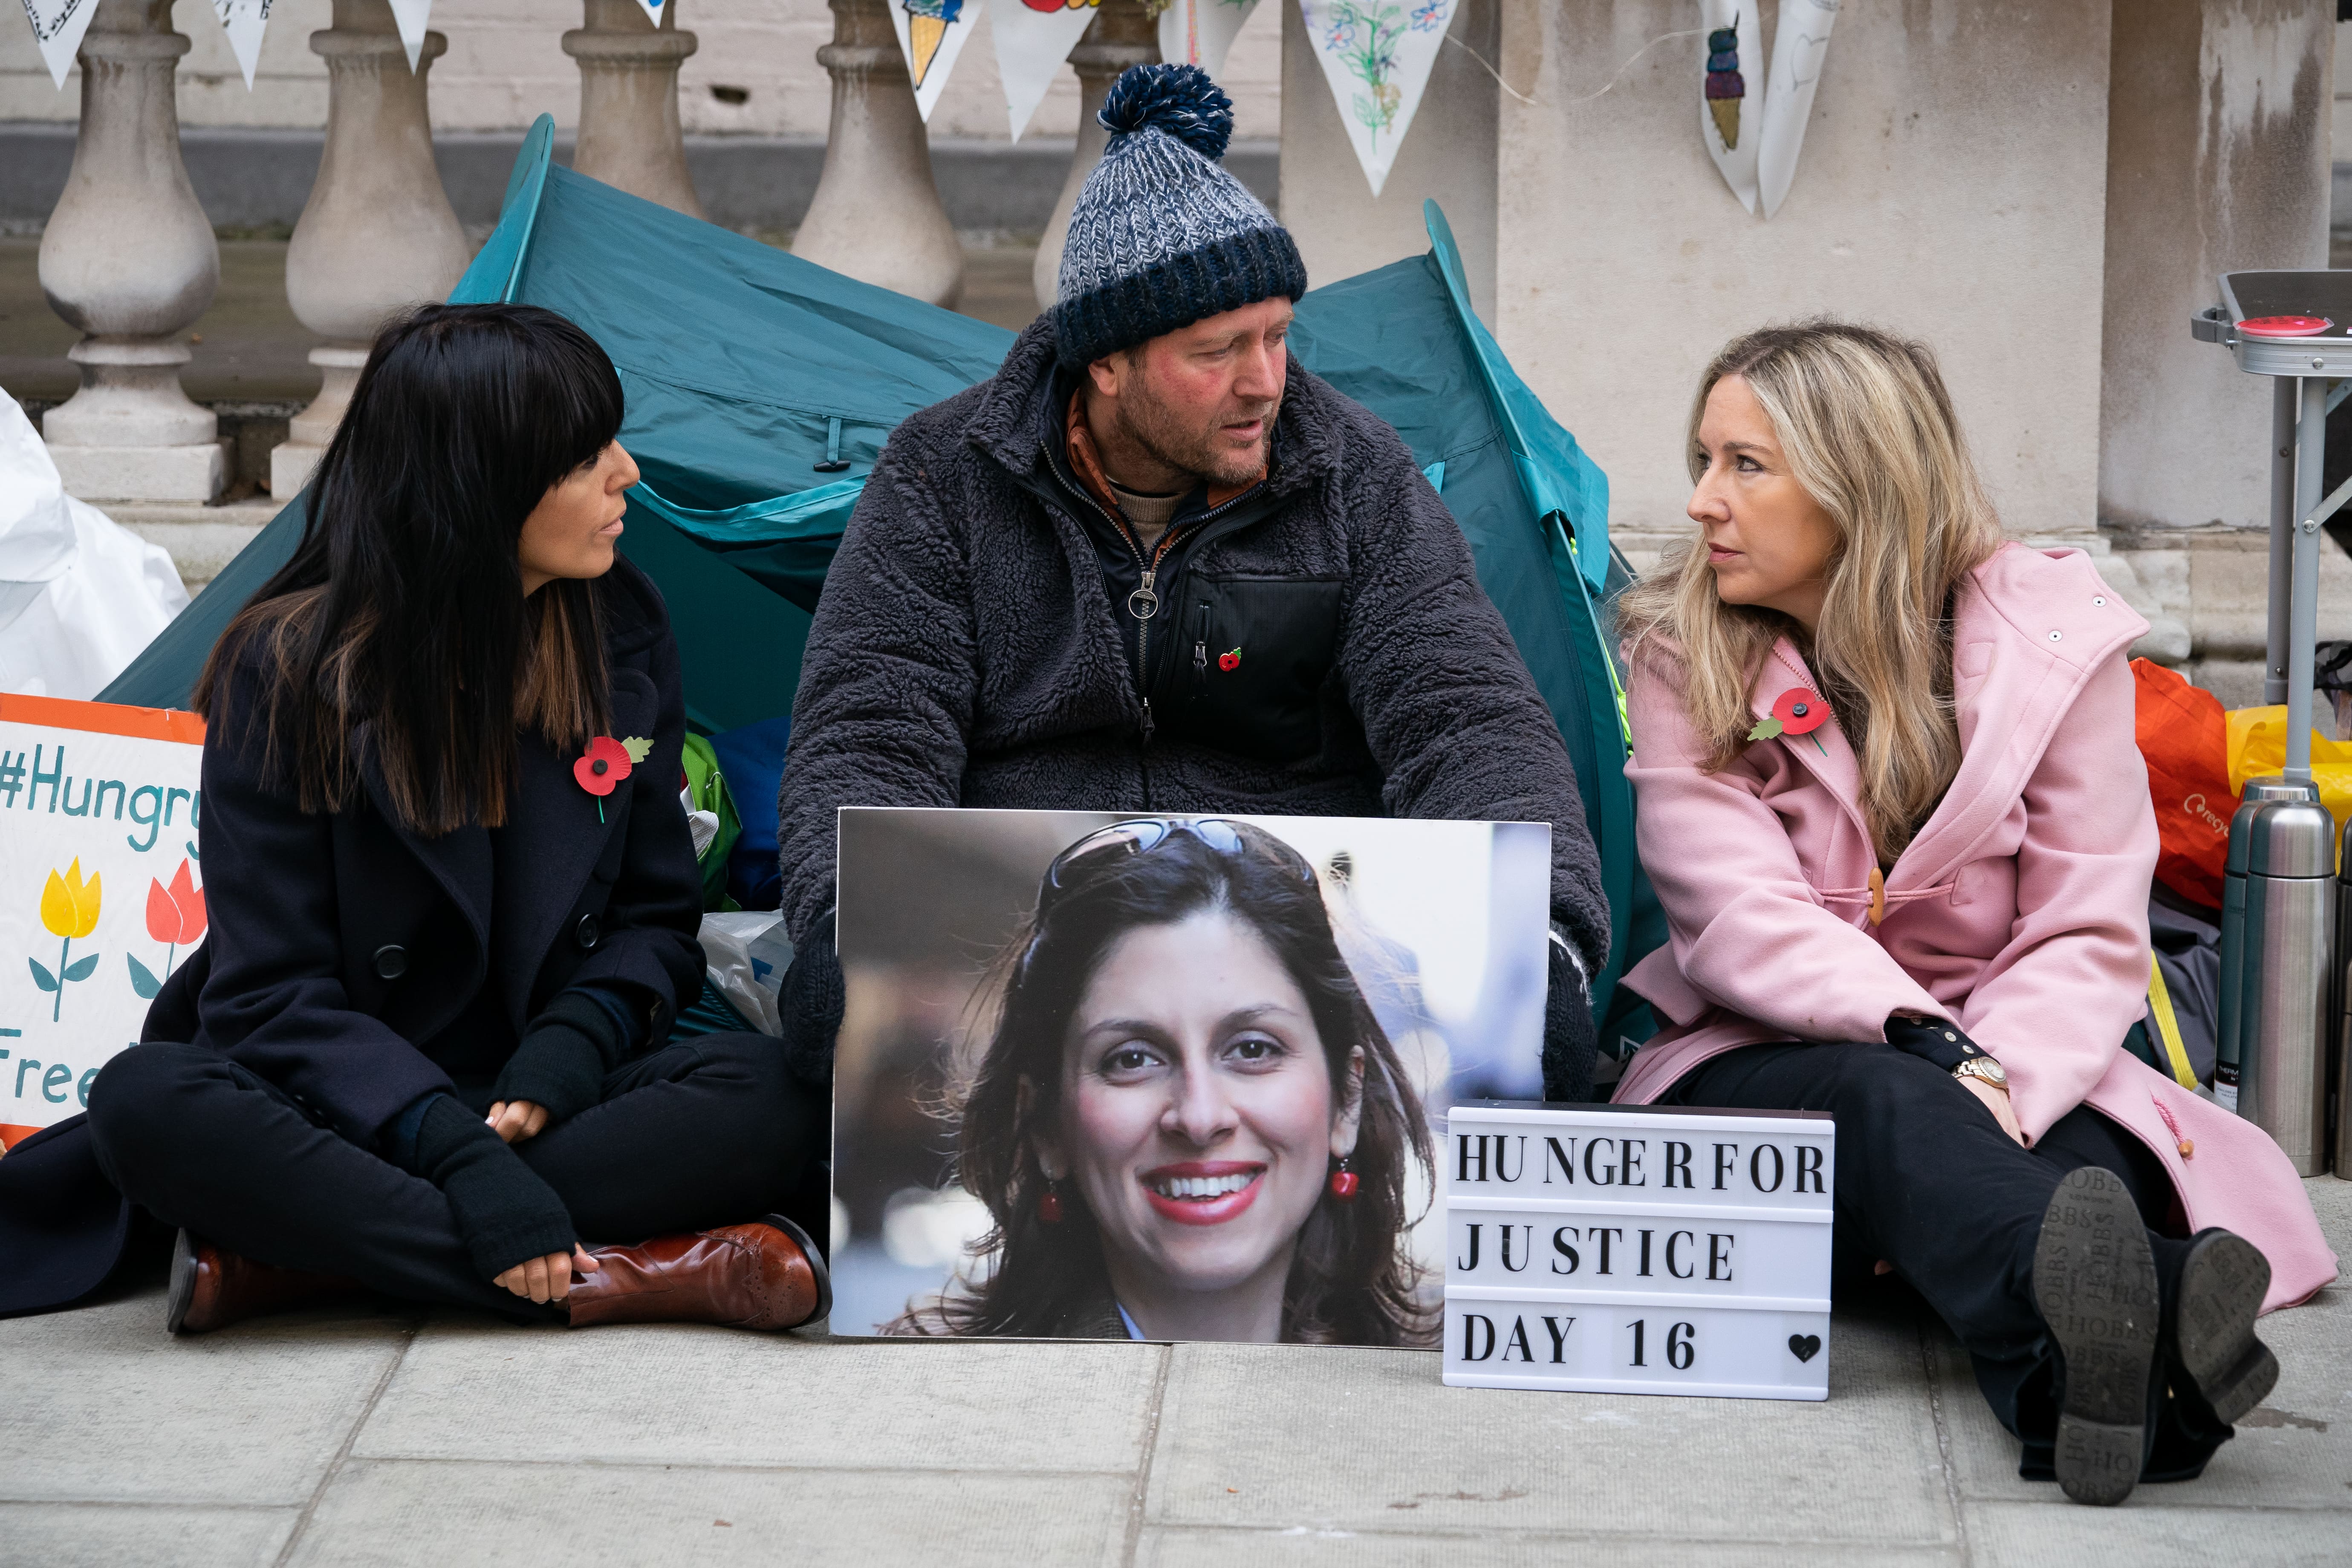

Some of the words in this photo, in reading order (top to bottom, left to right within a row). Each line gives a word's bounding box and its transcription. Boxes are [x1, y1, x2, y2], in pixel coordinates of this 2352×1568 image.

[1456, 1134, 1696, 1189] HUNGER
[1711, 1144, 1827, 1194] FOR
[1458, 1224, 1734, 1282] JUSTICE
[1461, 1314, 1577, 1364] DAY
[1626, 1320, 1696, 1370] 16
